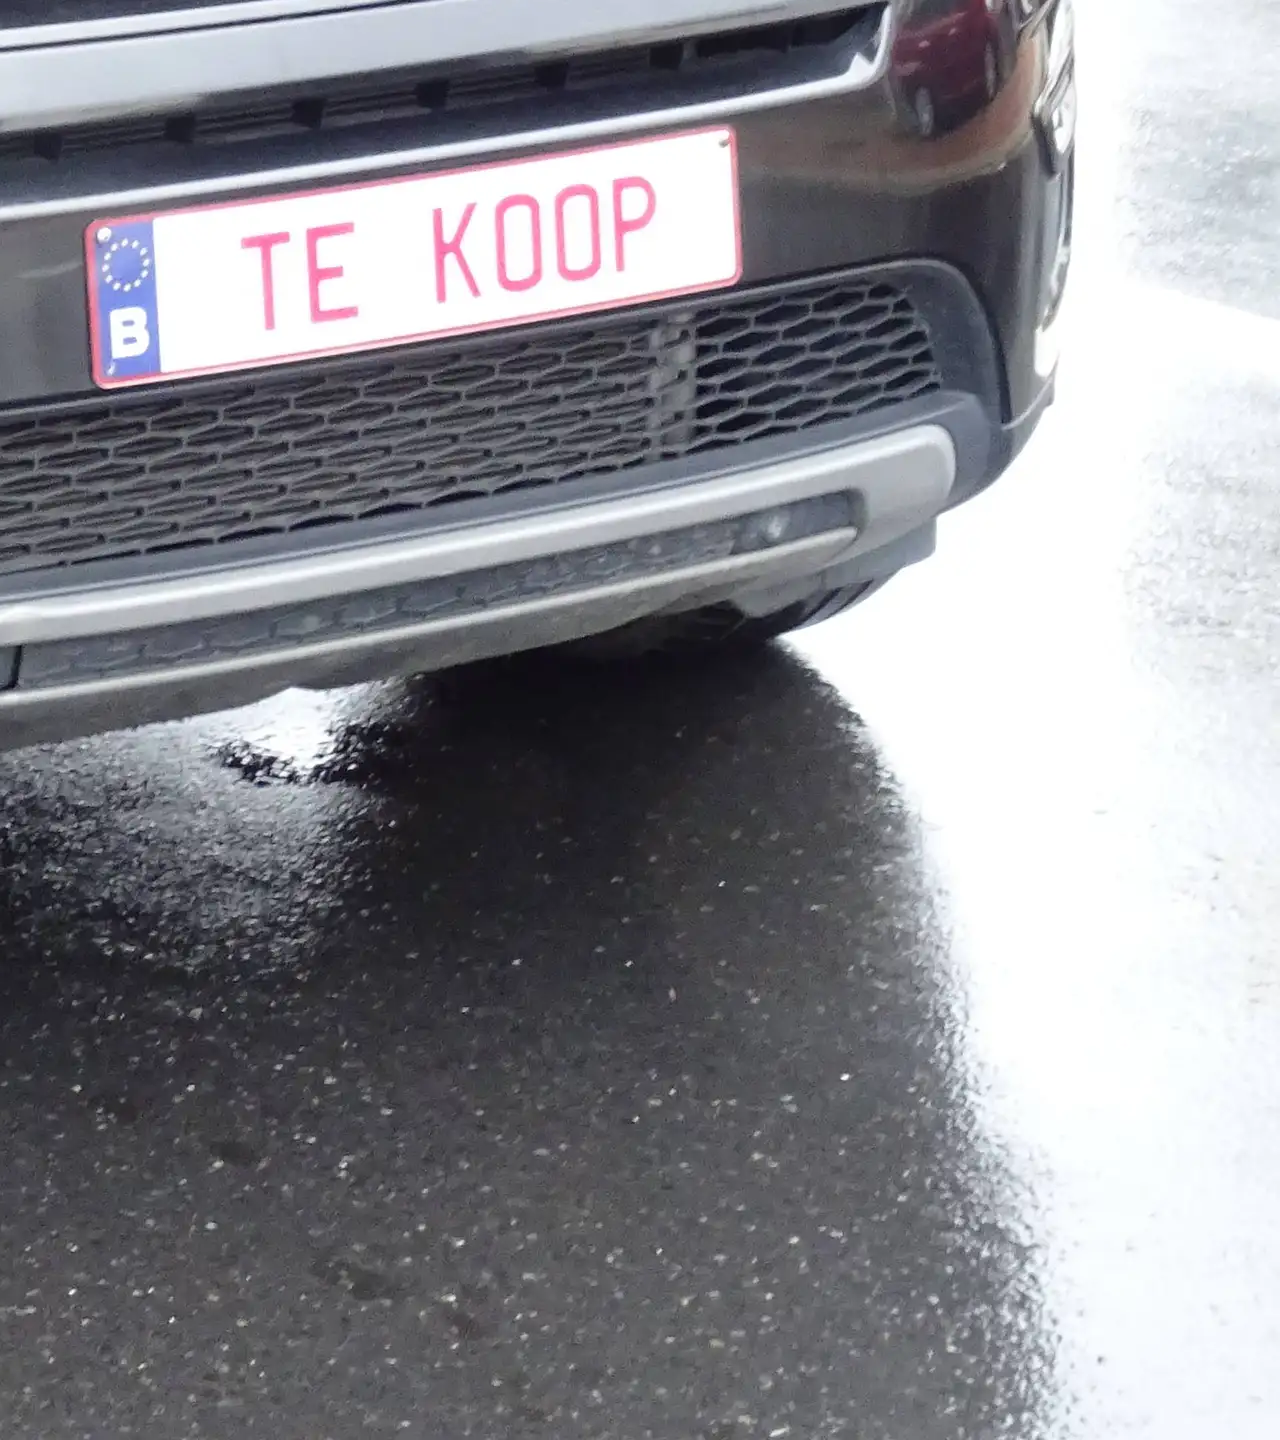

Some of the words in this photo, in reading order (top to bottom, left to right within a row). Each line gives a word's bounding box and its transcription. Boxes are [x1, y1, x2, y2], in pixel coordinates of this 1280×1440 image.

[241, 221, 359, 331] TE
[431, 175, 657, 304] KOOP
[108, 306, 150, 360] B
